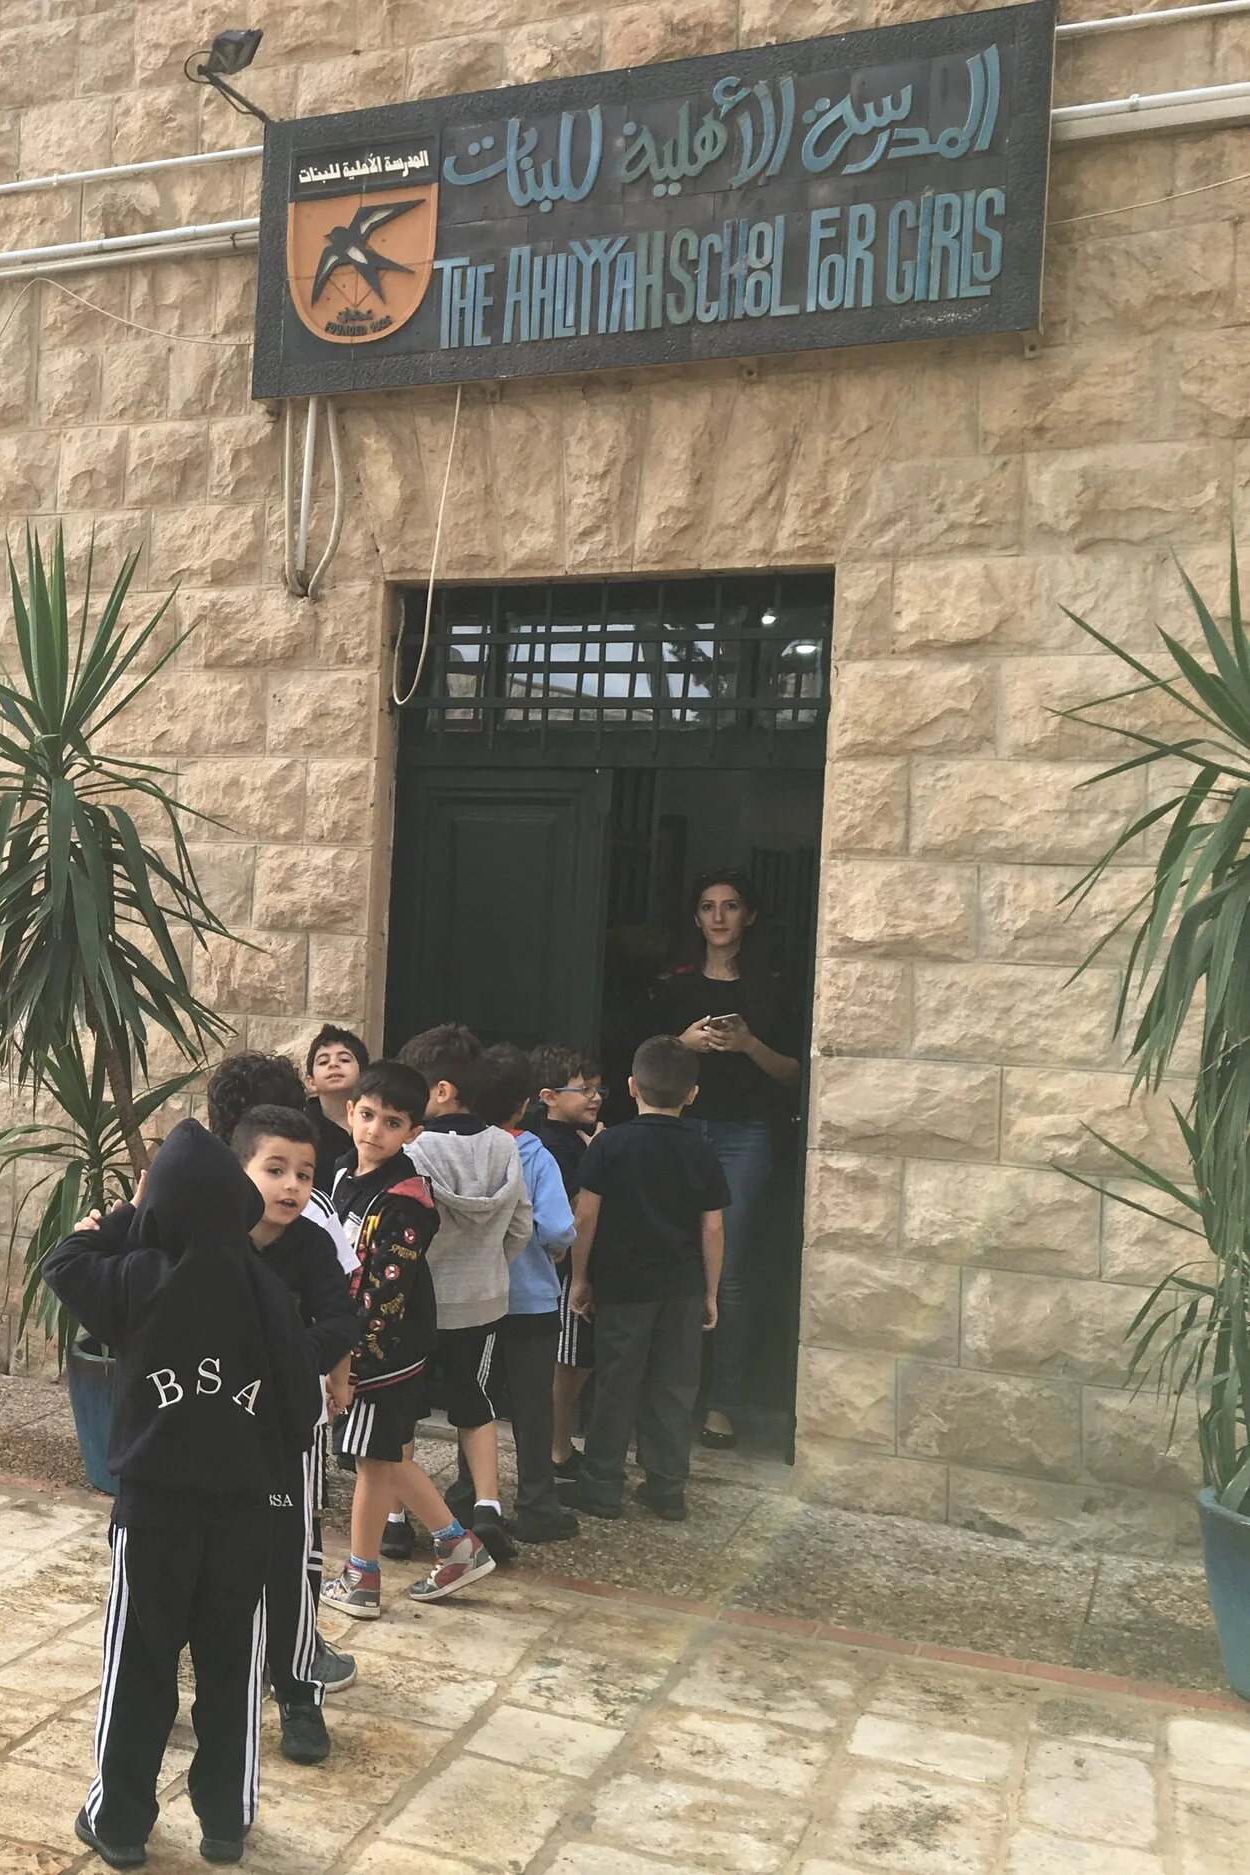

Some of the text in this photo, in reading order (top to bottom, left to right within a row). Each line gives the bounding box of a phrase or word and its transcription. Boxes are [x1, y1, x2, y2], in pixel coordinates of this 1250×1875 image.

[384, 150, 430, 177] المدرسة
[442, 104, 603, 213] للبنات
[801, 43, 1000, 176] المدرسة
[298, 163, 342, 183] للبنات
[433, 187, 1006, 349] THE AHLIYYAH SCHOOL FOR GIRLS
